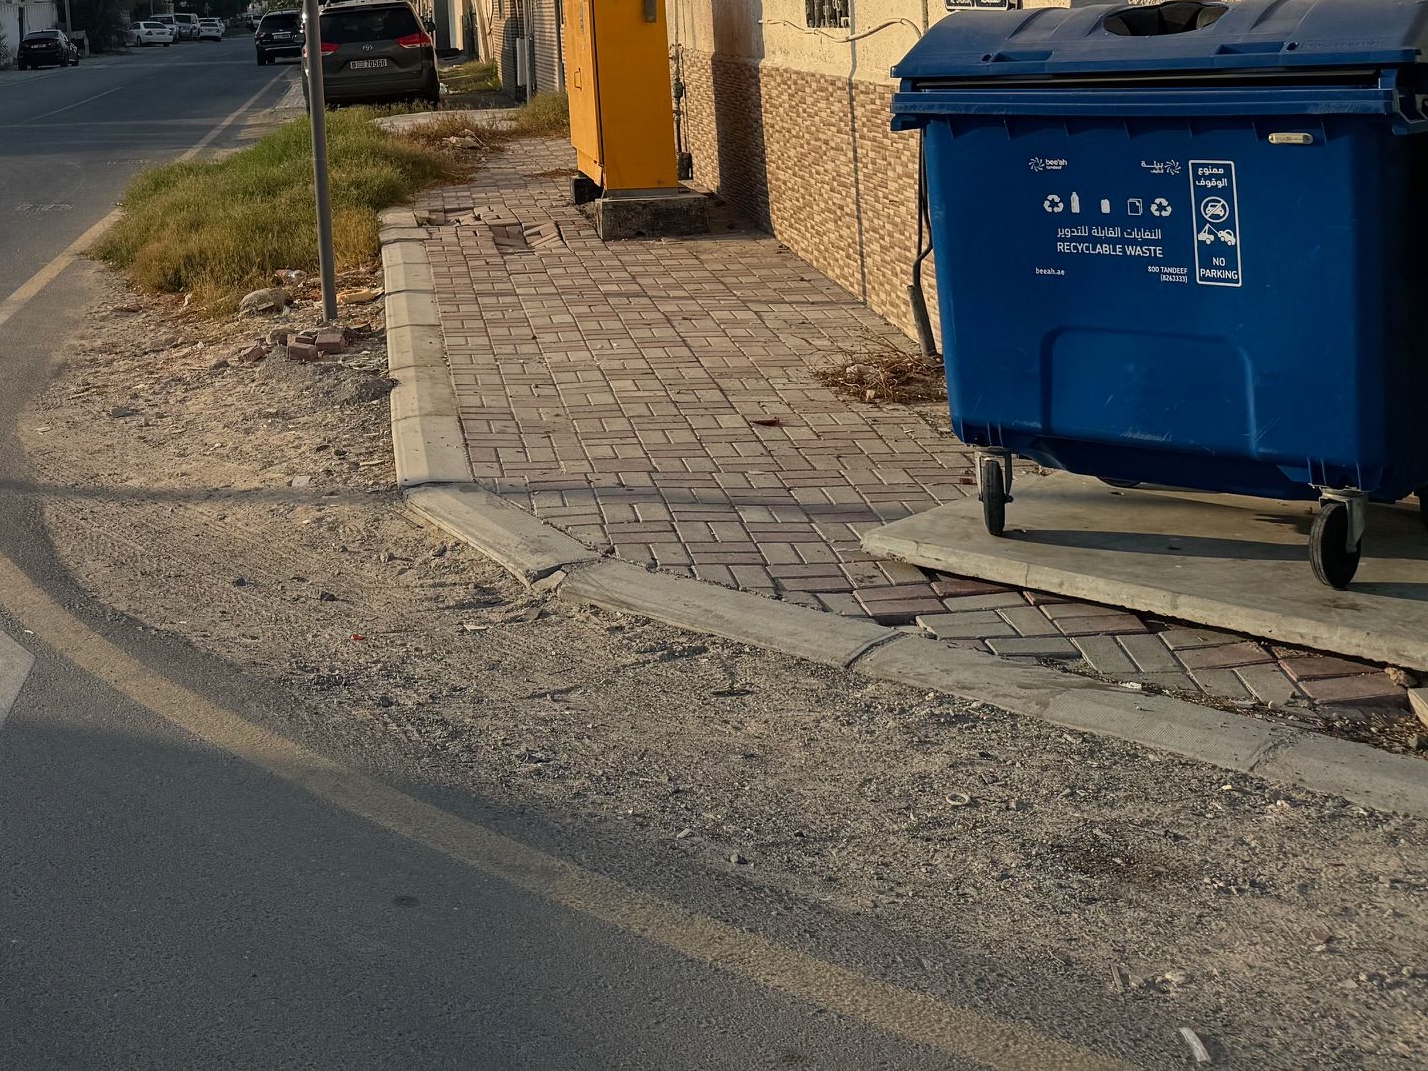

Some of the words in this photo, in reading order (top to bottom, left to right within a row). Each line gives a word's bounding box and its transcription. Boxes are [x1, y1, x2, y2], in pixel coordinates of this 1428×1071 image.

[1198, 165, 1224, 176] ممنوع
[1196, 178, 1228, 188] الوقوف
[1057, 226, 1088, 238] للتدوير
[1092, 226, 1121, 240] القابلة
[1124, 227, 1162, 241] النفايات
[1057, 242, 1123, 256] RECYCLABLE
[1125, 245, 1163, 257] WASTE
[1212, 257, 1226, 266] NO
[1035, 267, 1065, 276] beeah.ae
[1147, 265, 1160, 273] 800
[1160, 266, 1188, 275] TANDEEF
[1200, 268, 1238, 280] PARKING
